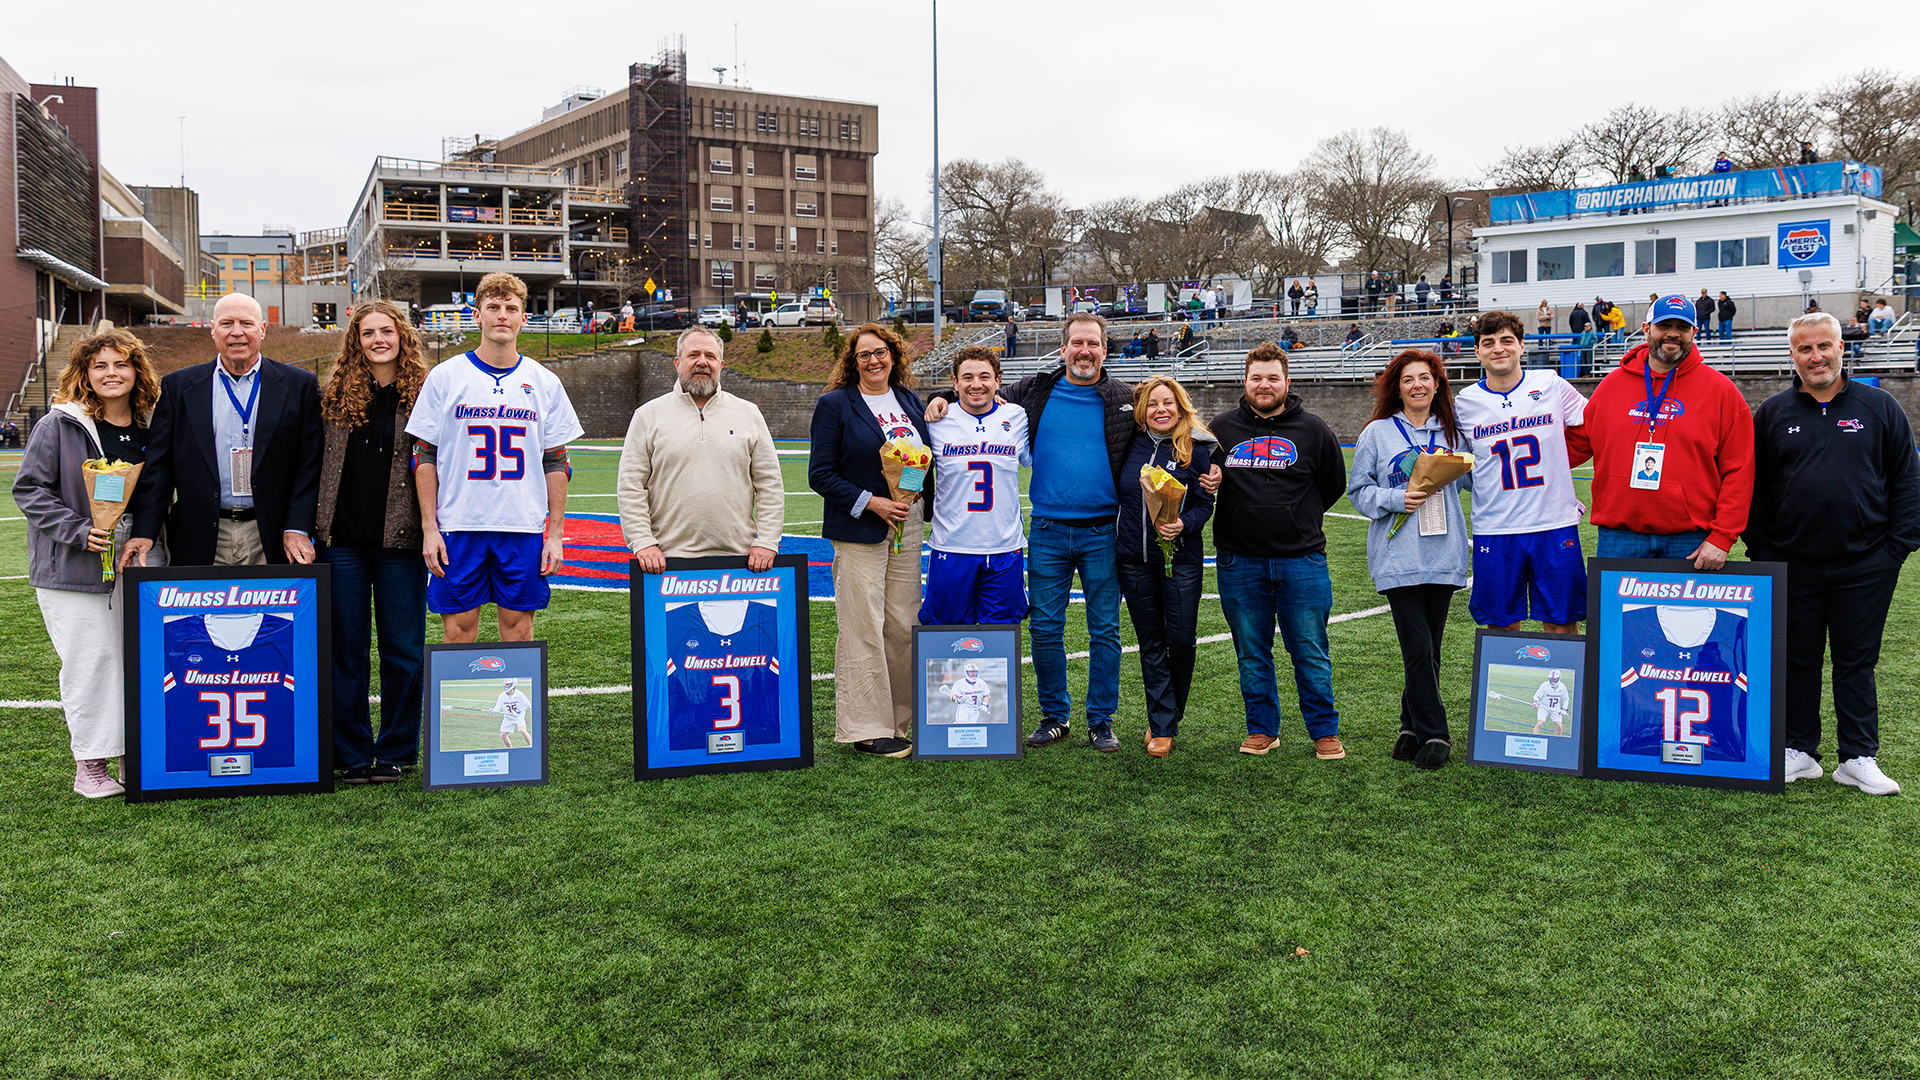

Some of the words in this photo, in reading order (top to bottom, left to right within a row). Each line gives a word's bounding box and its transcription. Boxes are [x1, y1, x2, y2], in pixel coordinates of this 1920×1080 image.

[1575, 178, 1737, 210] @RIVERHAWKNATION
[1781, 236, 1826, 248] AMERICA
[454, 404, 498, 420] UMASS
[496, 404, 538, 422] LOWELL
[1473, 421, 1510, 440] UMASS
[1509, 413, 1554, 432] LOWELL
[467, 425, 526, 480] 35
[942, 443, 980, 457] UMASS
[979, 441, 1016, 457] LOWELL
[1490, 434, 1545, 491] 12
[968, 461, 993, 512] 3
[157, 586, 226, 608] UMASS
[225, 585, 299, 607] LOWELL
[660, 575, 719, 596] UMASS
[718, 573, 781, 594] LOWELL
[1618, 576, 1682, 598] UMASS
[1681, 579, 1754, 602] LOWELL
[684, 655, 725, 669] UMASS
[724, 654, 767, 669] LOWELL
[1639, 663, 1682, 681] UMASS
[1681, 667, 1732, 684] LOWELL
[183, 669, 231, 685] UMASS
[229, 669, 281, 685] LOWELL
[712, 674, 741, 729] 3
[971, 695, 978, 705] 3
[199, 690, 267, 749] 35
[1655, 687, 1711, 746] 12
